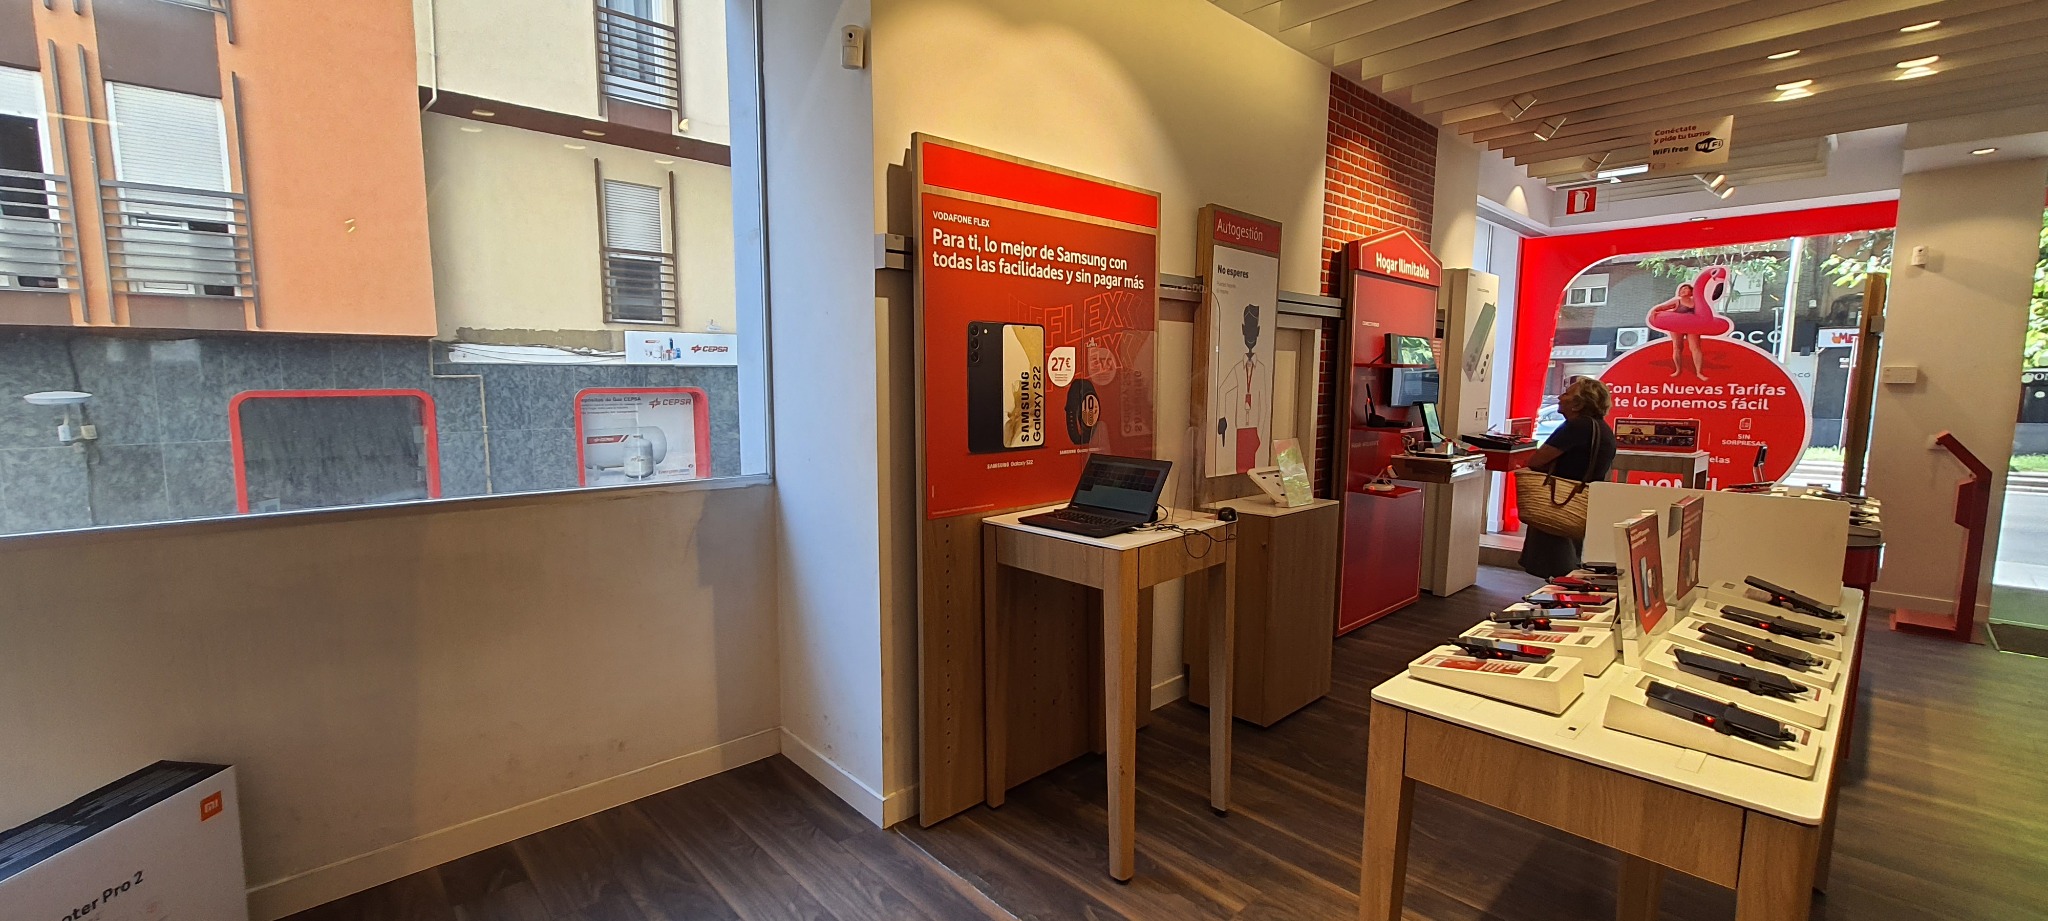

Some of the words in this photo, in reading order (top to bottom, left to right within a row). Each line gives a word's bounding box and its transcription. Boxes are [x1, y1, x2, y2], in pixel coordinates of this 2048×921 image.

[1654, 125, 1697, 136] Conéctate
[1660, 135, 1676, 144] pide
[1688, 130, 1710, 138] turno
[932, 210, 972, 225] VODAFONE
[974, 216, 990, 228] FLEX
[1216, 218, 1263, 242] Autogestión
[932, 228, 964, 249] Para
[968, 234, 982, 254] ti,
[984, 236, 998, 253] lo
[1000, 241, 1038, 260] mejor
[1040, 245, 1054, 261] de
[1056, 246, 1106, 271] Samsung
[1109, 257, 1127, 270] con
[932, 251, 973, 270] todas
[976, 256, 996, 273] las
[999, 258, 1064, 281] facilidades
[1066, 270, 1073, 284] y
[1076, 268, 1091, 284] sin
[1094, 272, 1122, 289] pagar
[1124, 274, 1144, 289] más
[1217, 264, 1226, 274] No
[1227, 268, 1249, 278] esperes
[1376, 252, 1398, 275] Hogar
[1398, 258, 1430, 280] Ilimitable
[1033, 366, 1041, 389] S22
[1606, 383, 1631, 394] Con
[1636, 383, 1658, 394] las
[1662, 384, 1723, 395] Nuevas
[1728, 384, 1786, 396] Tarifas
[1021, 372, 1029, 442] SAMSUNG
[1614, 397, 1629, 408] te
[1633, 397, 1647, 408] lo
[1651, 400, 1727, 410] ponemos
[1731, 398, 1768, 410] fácil
[1033, 392, 1043, 442] Galaxy
[102, 881, 130, 903] Pro
[134, 870, 144, 885] 2
